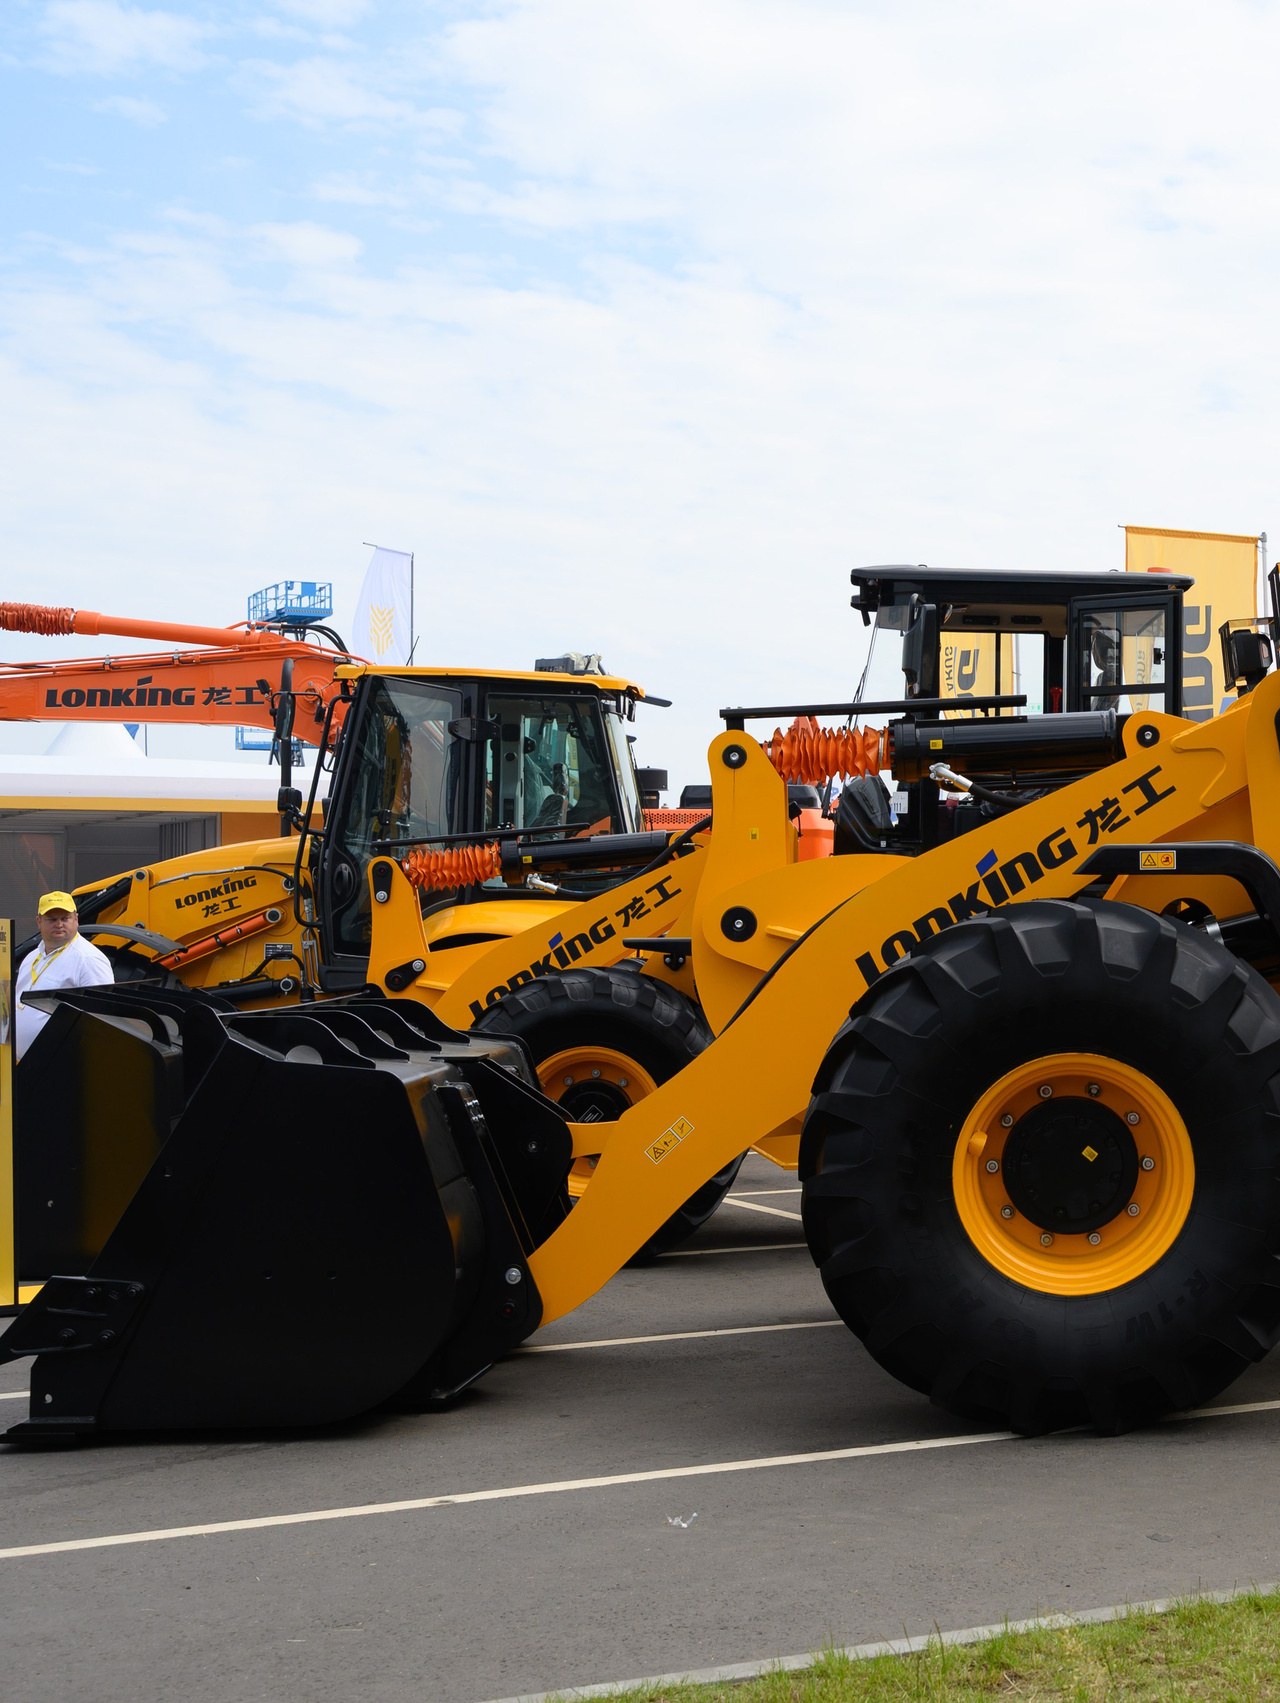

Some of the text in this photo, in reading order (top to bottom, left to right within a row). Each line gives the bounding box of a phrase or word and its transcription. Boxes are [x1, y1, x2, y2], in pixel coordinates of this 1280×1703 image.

[202, 686, 265, 706] 龙工
[1076, 765, 1177, 845] 龙工
[202, 896, 242, 918] 龙工
[615, 875, 682, 927] 龙工
